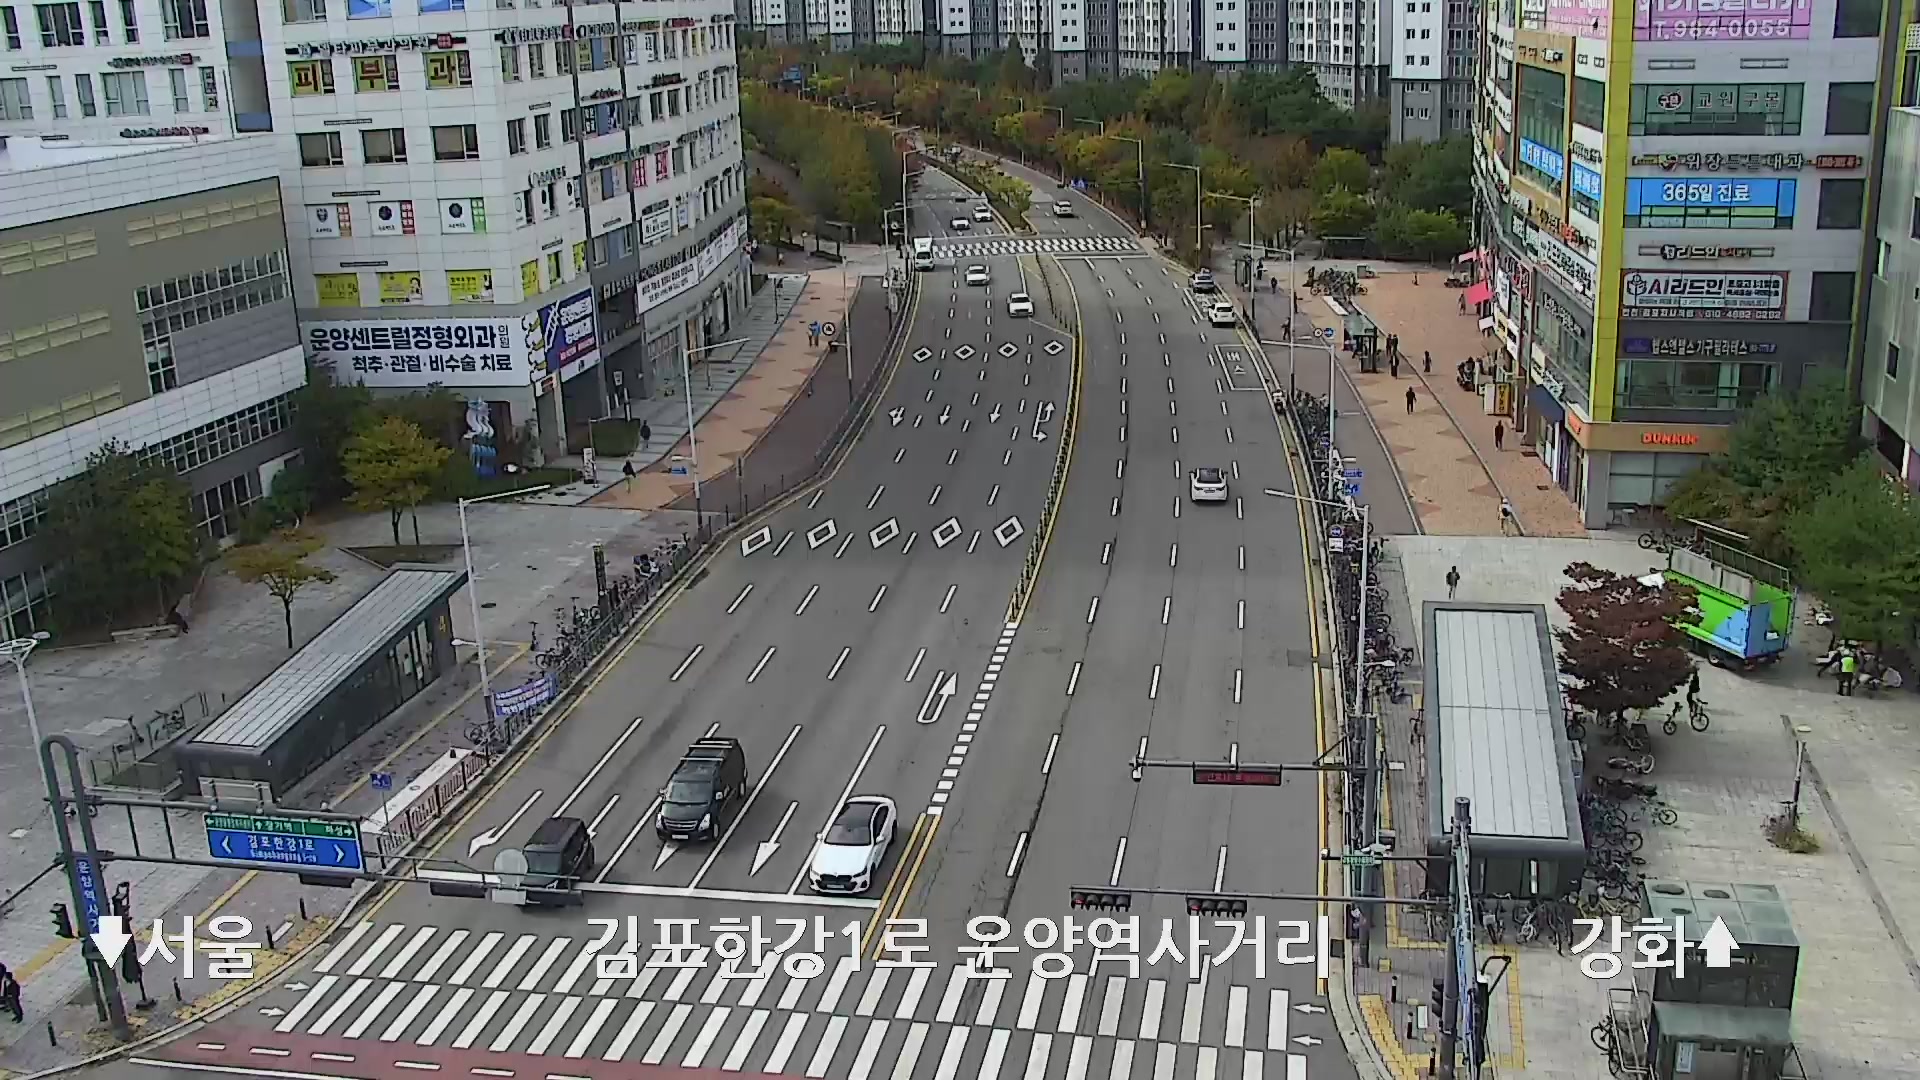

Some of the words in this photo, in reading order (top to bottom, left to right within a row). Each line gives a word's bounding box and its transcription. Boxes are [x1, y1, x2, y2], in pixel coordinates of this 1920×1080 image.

[1695, 91, 1735, 109] 교원
[1662, 183, 1713, 203] 365일
[1717, 183, 1751, 203] 진료
[1648, 278, 1724, 296] AI리드인
[309, 325, 497, 352] 운양센트럴정형외과
[480, 354, 513, 372] 치료
[247, 834, 316, 853] 김포한강1로
